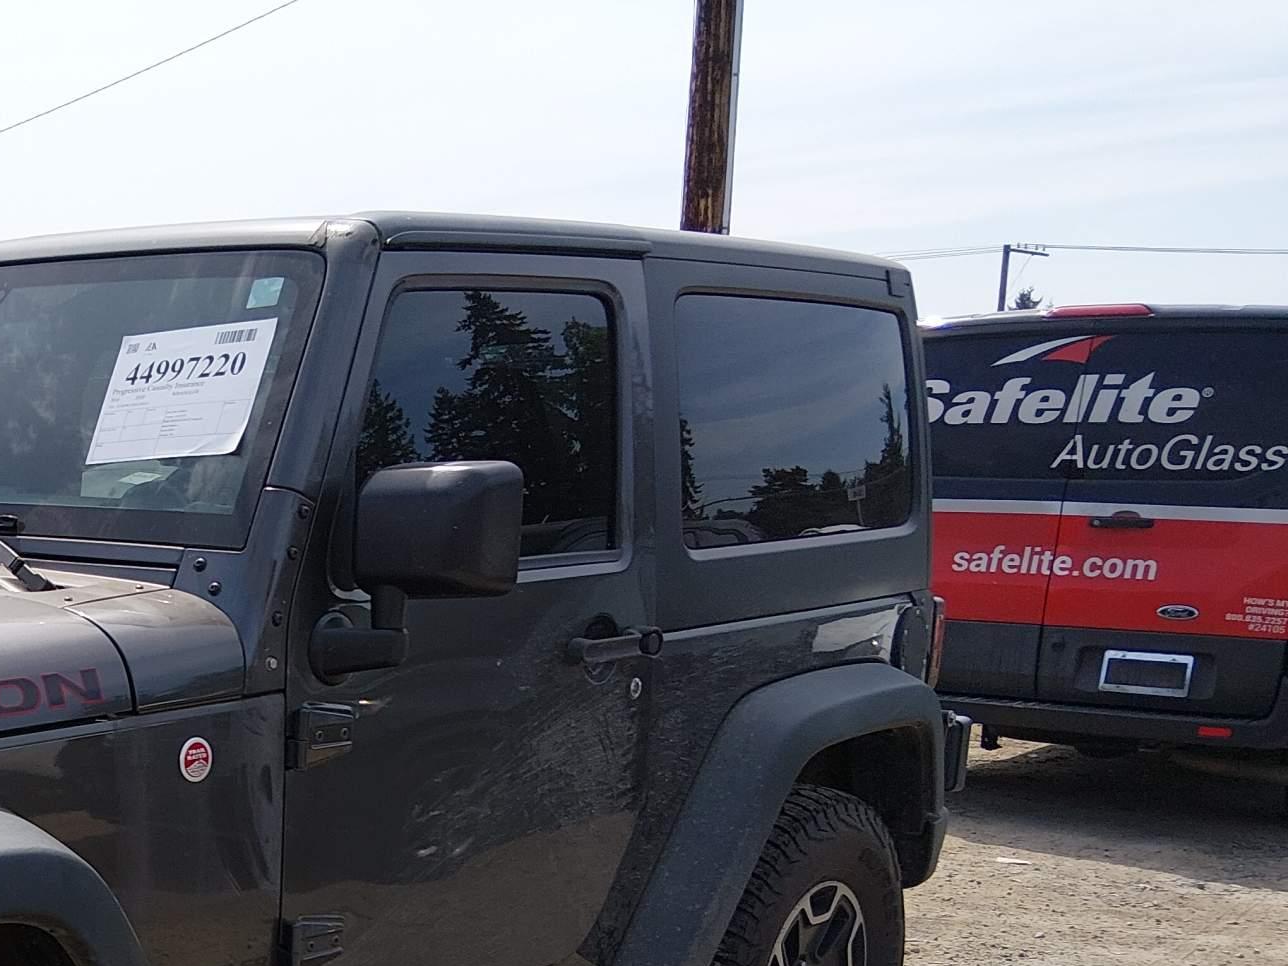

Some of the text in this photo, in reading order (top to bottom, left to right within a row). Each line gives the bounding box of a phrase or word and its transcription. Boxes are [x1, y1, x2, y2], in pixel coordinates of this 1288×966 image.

[125, 351, 248, 386] 44997220
[1051, 434, 1288, 472] AutoGlass
[951, 545, 1158, 581] safelite.com
